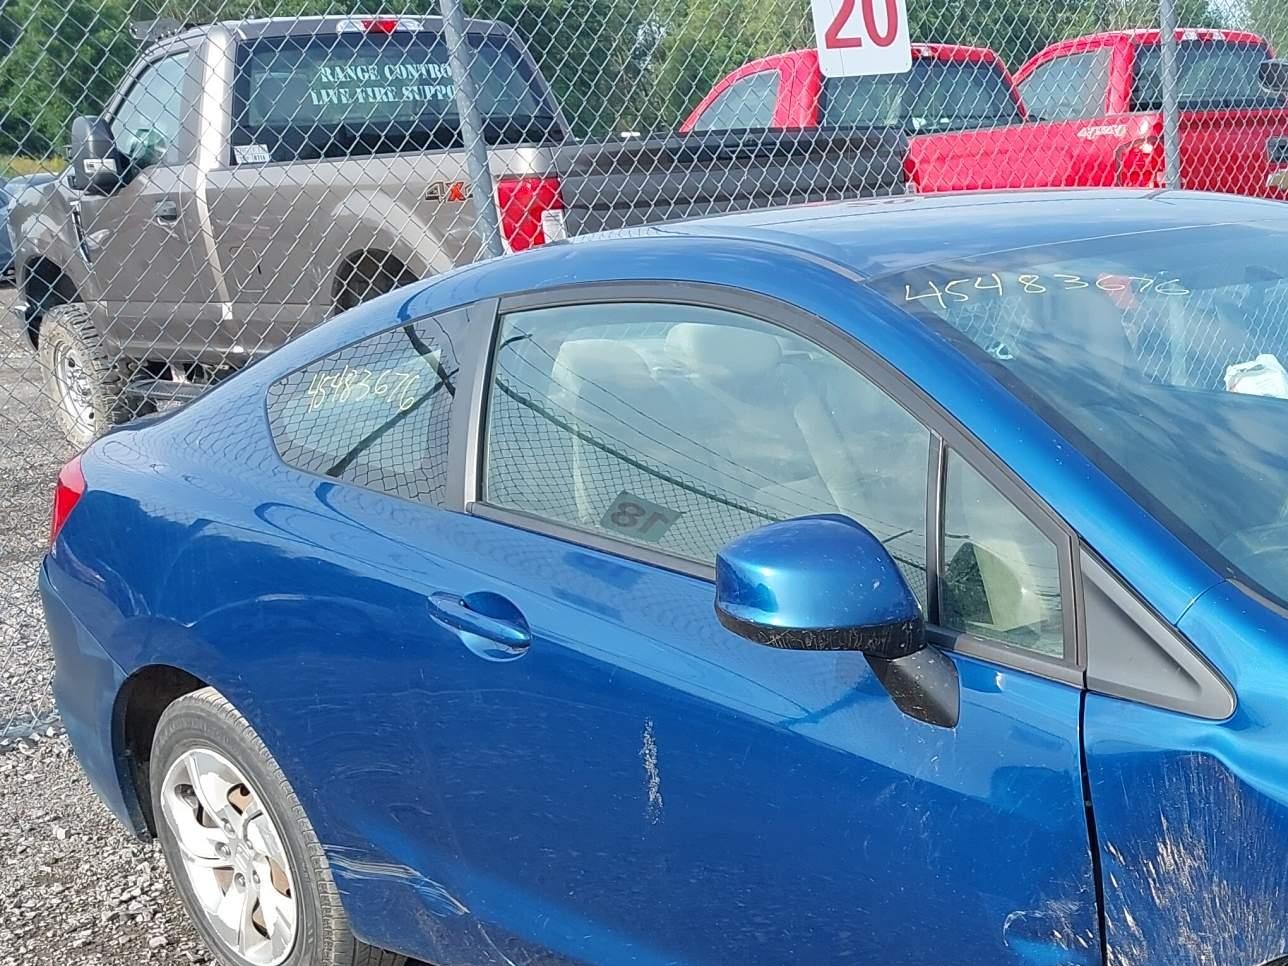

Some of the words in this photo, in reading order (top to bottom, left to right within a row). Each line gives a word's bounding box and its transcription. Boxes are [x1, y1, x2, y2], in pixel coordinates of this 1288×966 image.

[825, 0, 898, 49] 20
[319, 65, 381, 82] RANGE
[384, 63, 453, 80] CONTRO
[310, 88, 351, 105] LIVE
[356, 86, 399, 103] FIRE
[401, 84, 458, 101] SUPPO
[905, 272, 1191, 309] 45483676
[307, 364, 420, 413] 45483676
